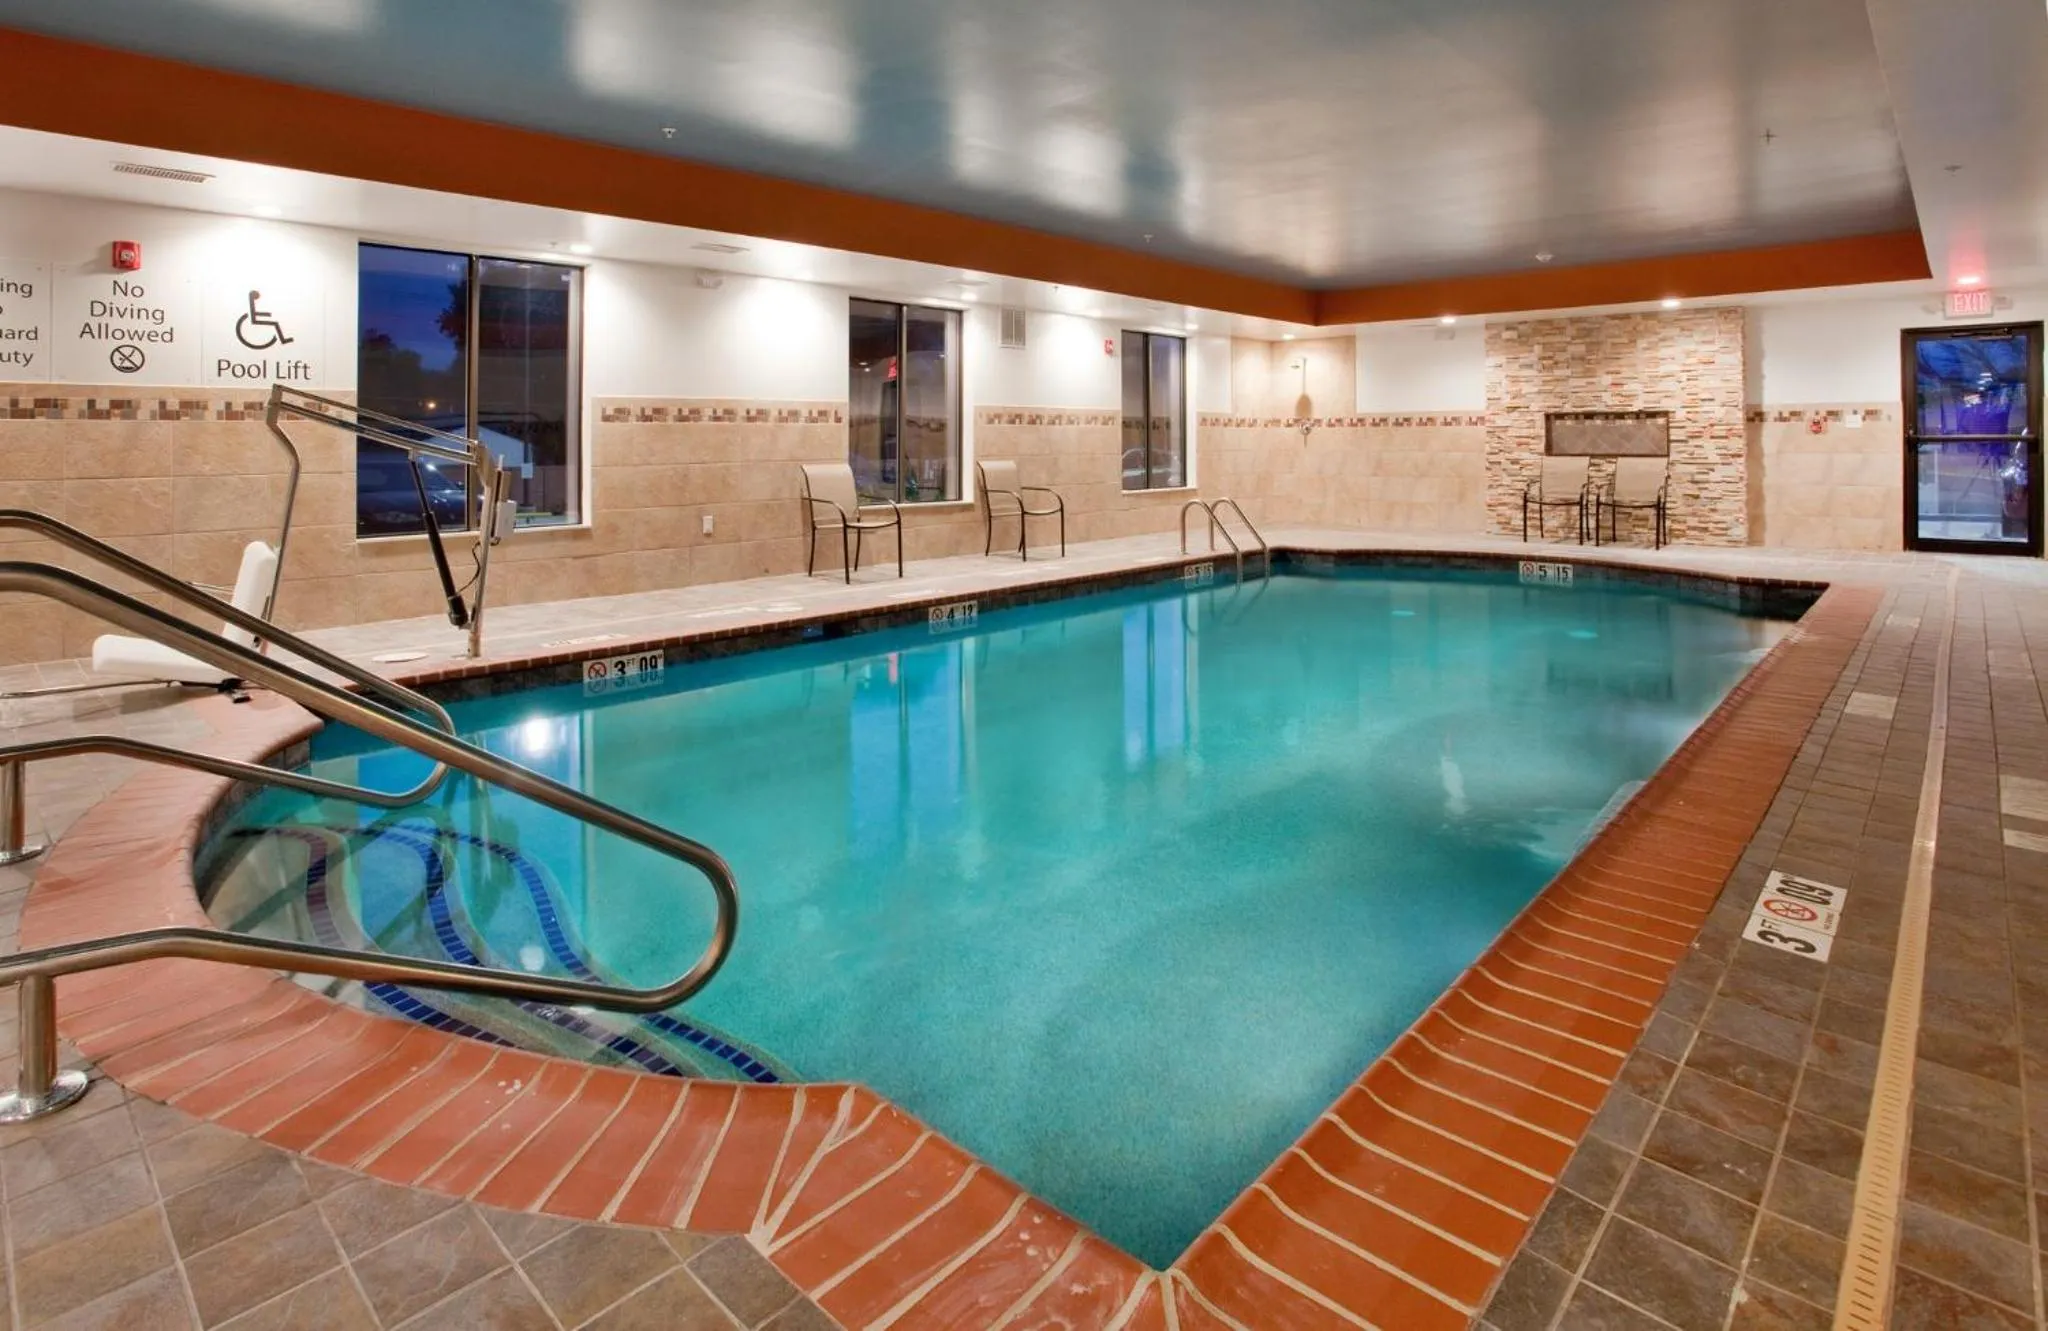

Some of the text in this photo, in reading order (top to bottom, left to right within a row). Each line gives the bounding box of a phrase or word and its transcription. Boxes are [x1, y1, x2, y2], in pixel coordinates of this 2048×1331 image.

[112, 280, 145, 298] No
[90, 300, 165, 325] Diving
[1954, 292, 1986, 312] EXIT
[79, 322, 174, 343] Allowed
[217, 359, 311, 380] Pool Lift
[614, 660, 626, 676] 3
[1776, 879, 1834, 906] 09
[1757, 930, 1817, 954] 3
